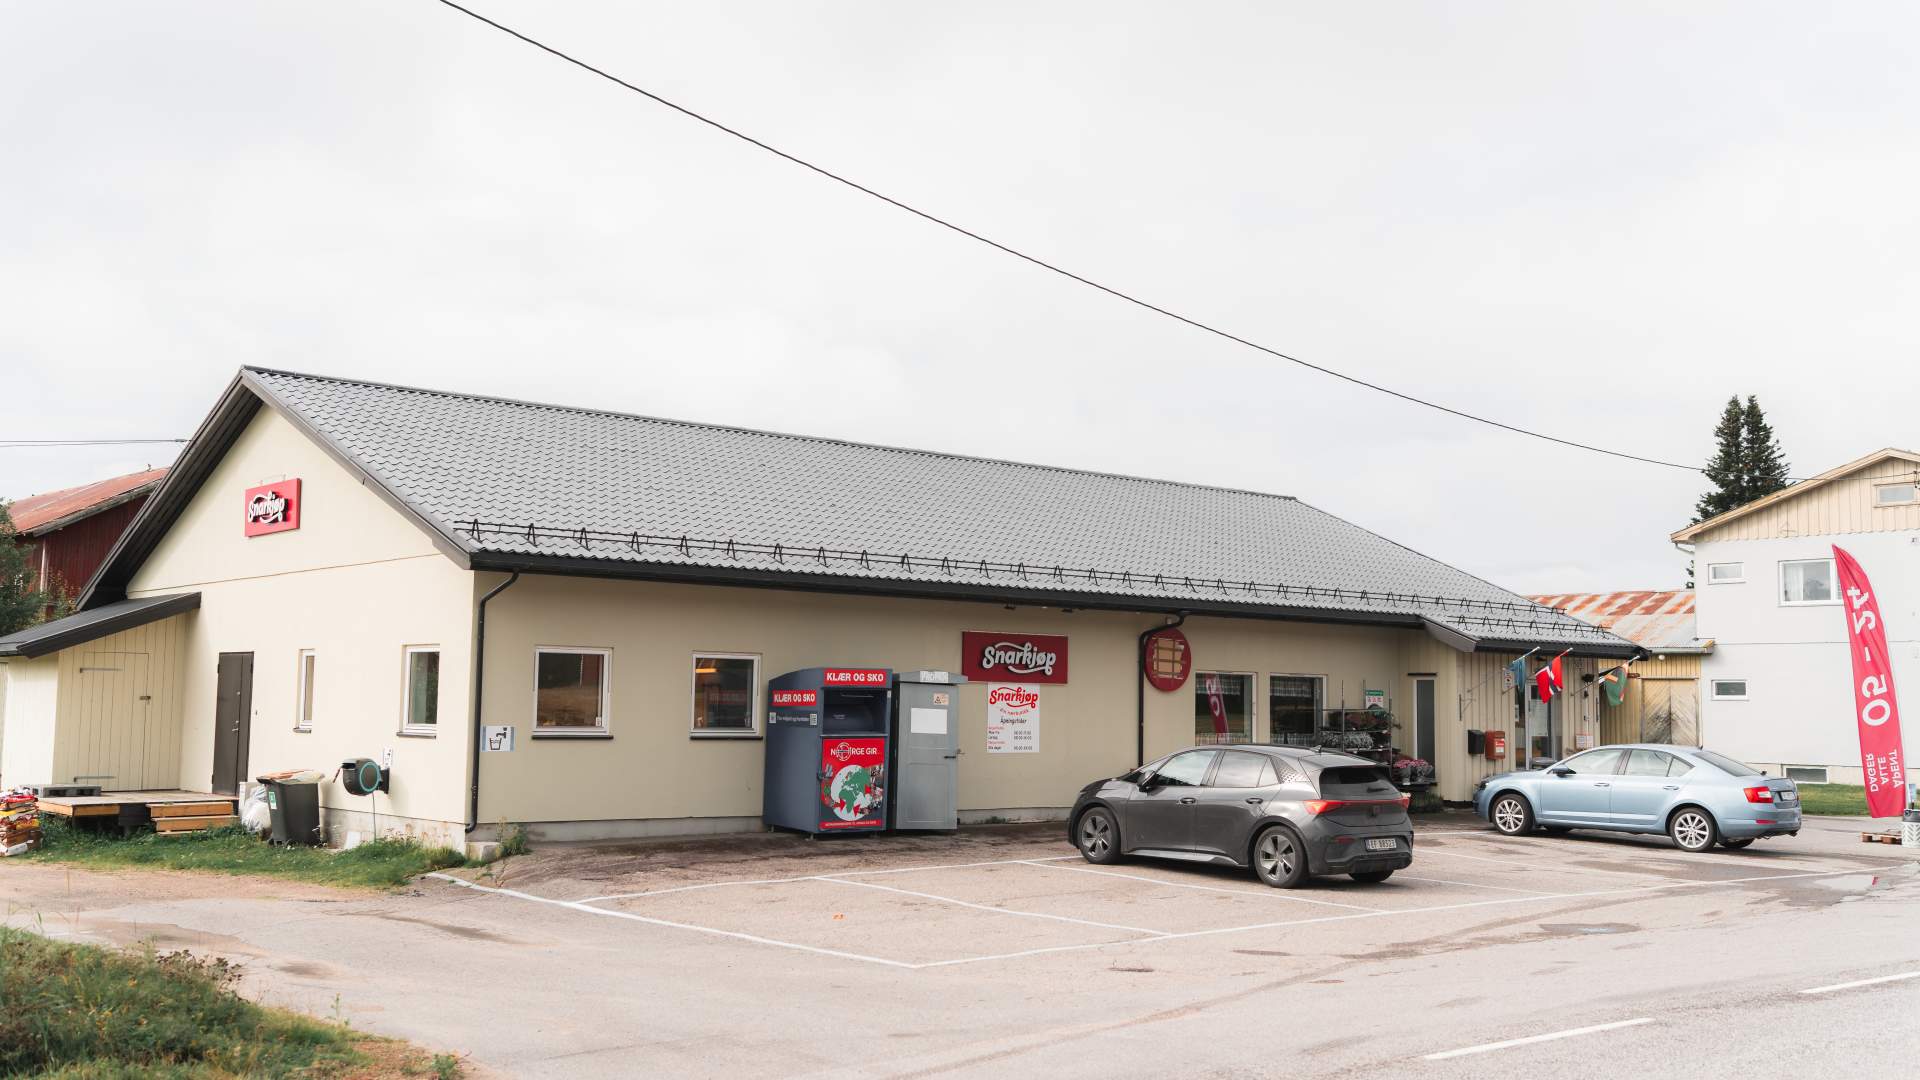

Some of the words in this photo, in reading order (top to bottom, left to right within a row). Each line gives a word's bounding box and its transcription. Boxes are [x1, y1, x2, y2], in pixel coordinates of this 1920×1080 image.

[248, 490, 285, 524] Snarkjøp
[982, 642, 1057, 676] Snarkjøp
[827, 673, 851, 682] KLÆR
[853, 673, 865, 682] OG
[867, 673, 884, 682] SKO
[774, 693, 792, 702] KLÆR
[793, 693, 802, 702] OG
[802, 693, 815, 702] SKO
[989, 687, 1038, 708] Snarkjøp
[866, 747, 877, 755] GIR
